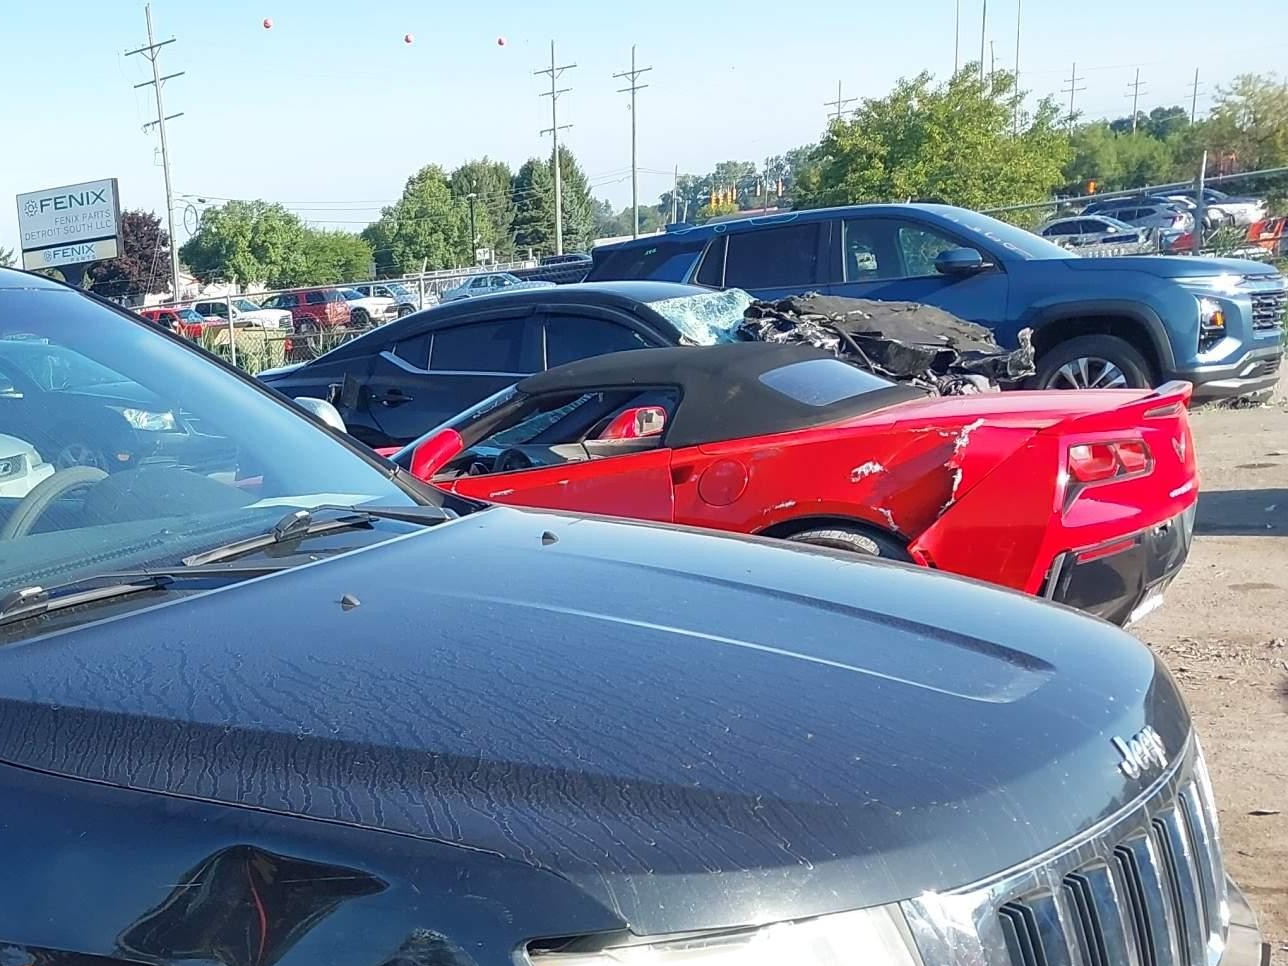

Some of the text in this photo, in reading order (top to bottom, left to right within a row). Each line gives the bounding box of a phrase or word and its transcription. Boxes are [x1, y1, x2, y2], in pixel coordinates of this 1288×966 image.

[39, 189, 107, 213] FENIX
[54, 209, 111, 226] FENIX PARTS
[24, 220, 112, 241] DETROIT SOUTH LLC
[53, 243, 95, 259] FENIX
[1111, 725, 1169, 779] Jeep
